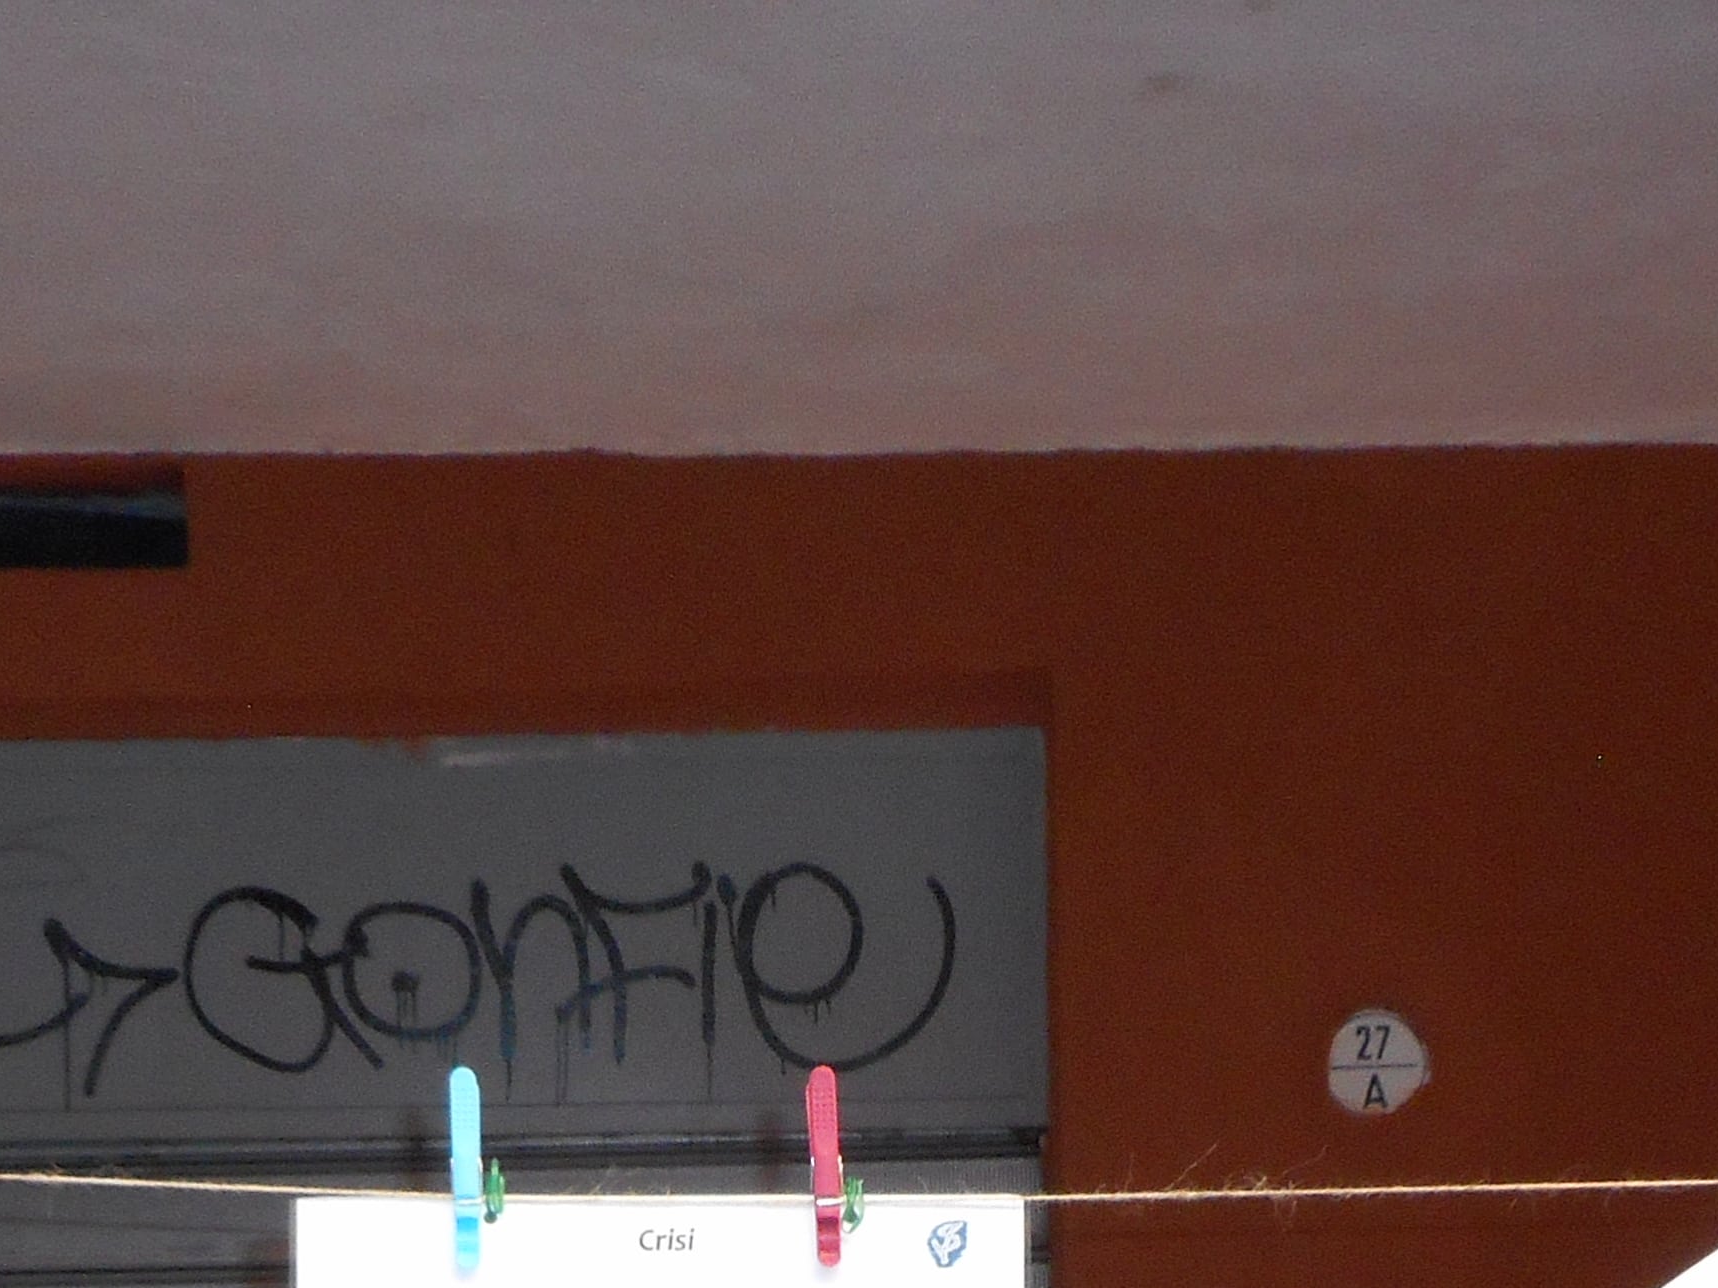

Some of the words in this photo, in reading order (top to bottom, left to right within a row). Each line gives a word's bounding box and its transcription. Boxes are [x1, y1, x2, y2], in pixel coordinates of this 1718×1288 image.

[1356, 1025, 1391, 1061] 27
[1363, 1073, 1388, 1109] A
[638, 1227, 696, 1252] Crisi
